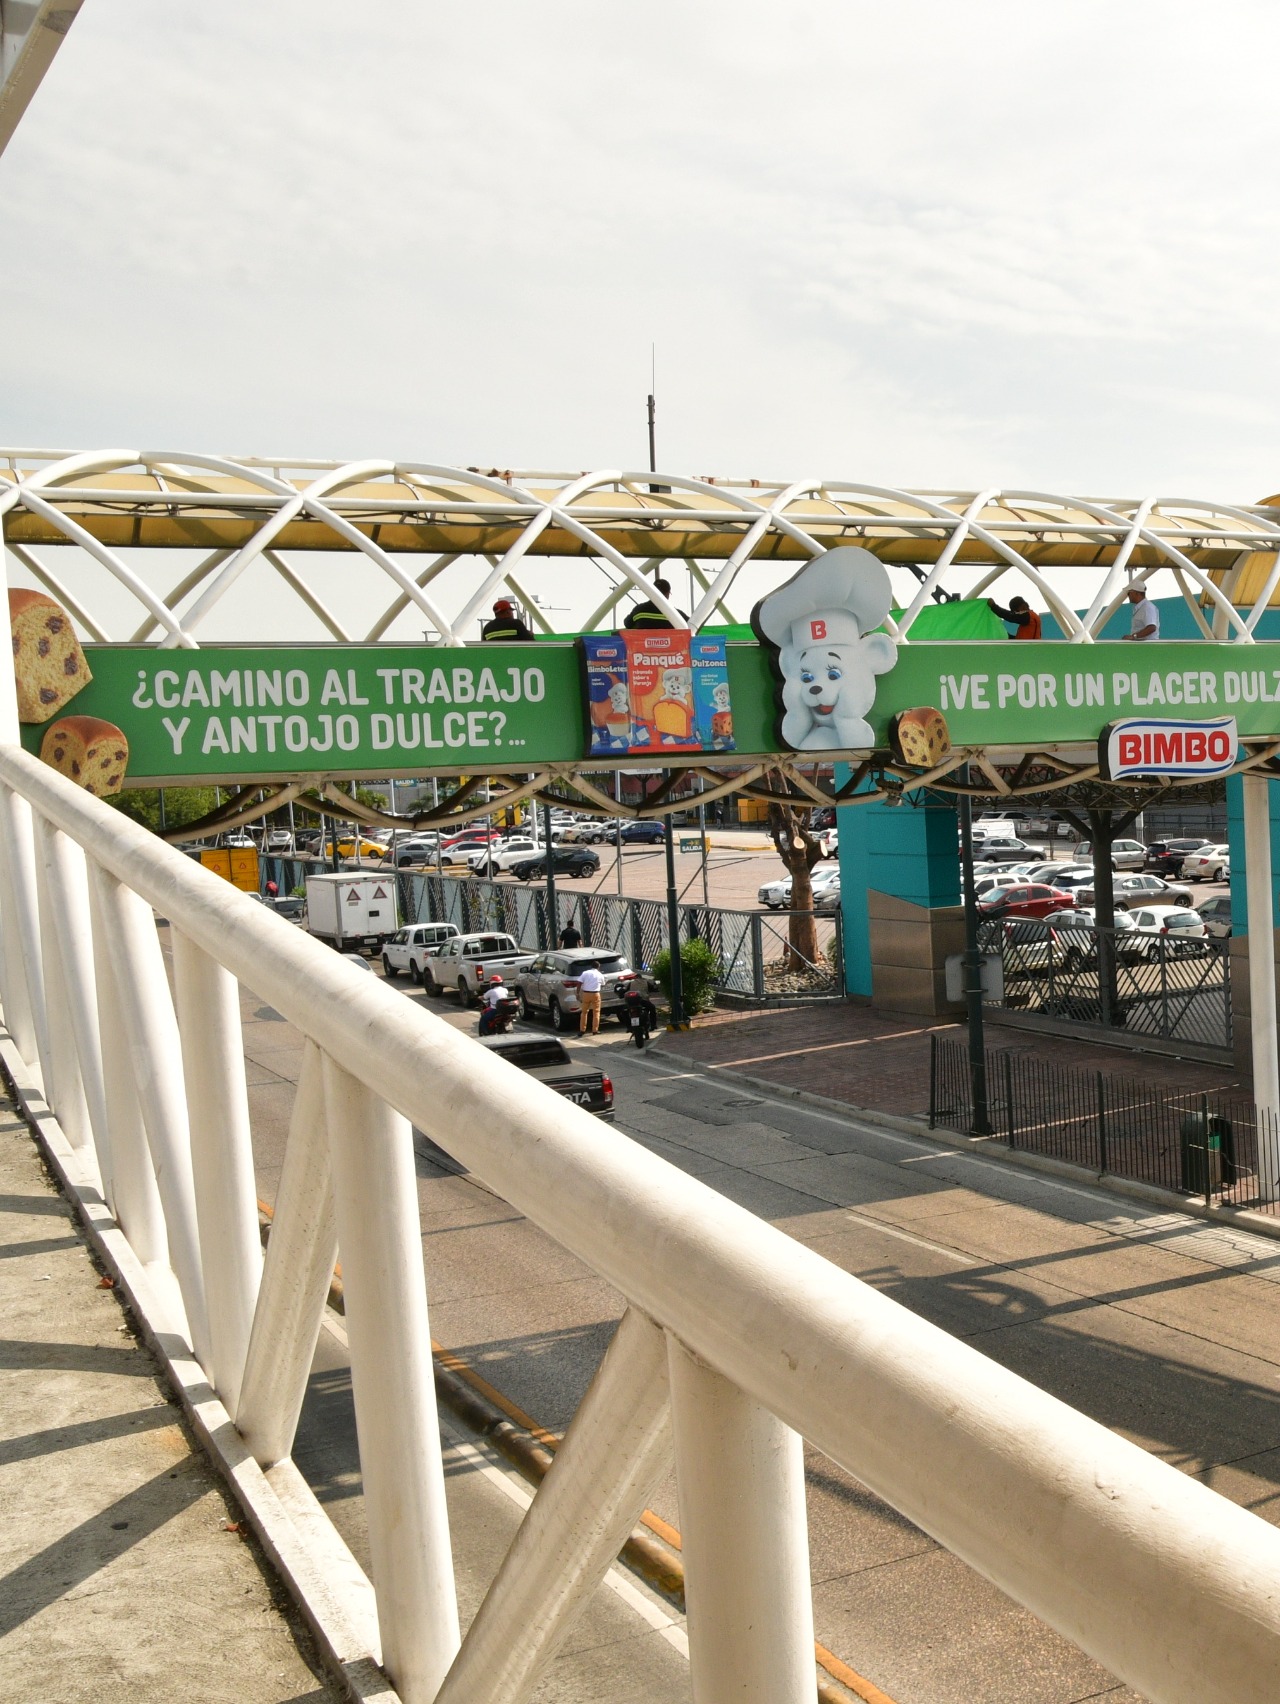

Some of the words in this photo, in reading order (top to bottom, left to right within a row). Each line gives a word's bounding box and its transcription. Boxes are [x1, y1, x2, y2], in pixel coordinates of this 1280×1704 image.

[810, 620, 827, 640] B
[633, 652, 684, 668] Panqué
[132, 669, 310, 709] ¿CAMINO
[320, 668, 370, 706] AL
[376, 667, 545, 705] TRABAJO
[939, 674, 991, 711] ¡VE
[997, 673, 1058, 709] POR
[1064, 672, 1105, 708] UN
[1112, 671, 1218, 706] PLACER
[161, 717, 191, 755] Y
[201, 714, 360, 755] ANTOJO
[1118, 731, 1231, 766] BIMBO
